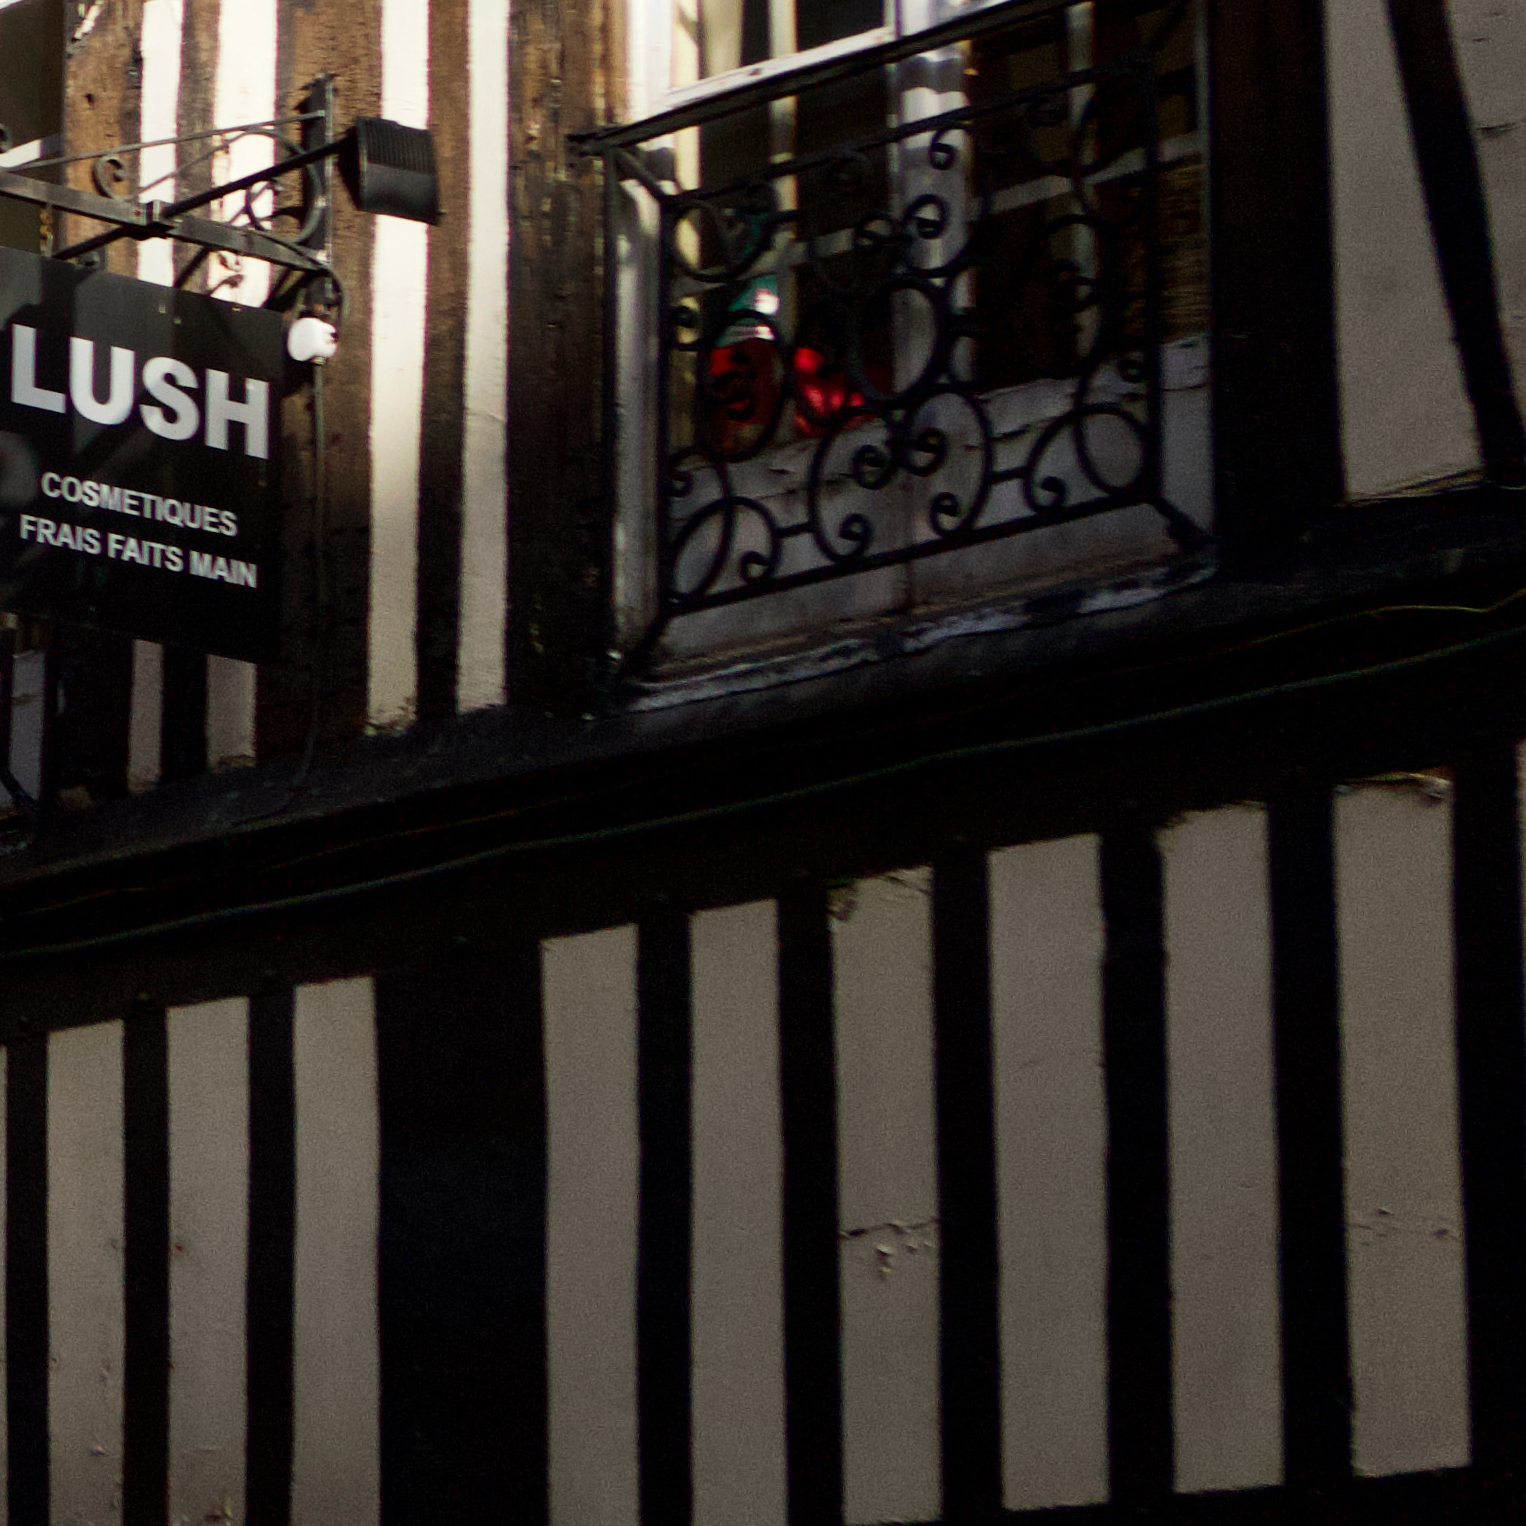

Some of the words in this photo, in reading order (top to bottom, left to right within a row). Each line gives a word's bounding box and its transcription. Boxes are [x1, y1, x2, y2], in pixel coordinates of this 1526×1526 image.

[11, 323, 270, 460] LUSH
[41, 471, 239, 538] COSMETIQUES
[20, 513, 102, 556] FRAIS
[107, 533, 184, 574] FAITS
[189, 550, 259, 589] MAIN
